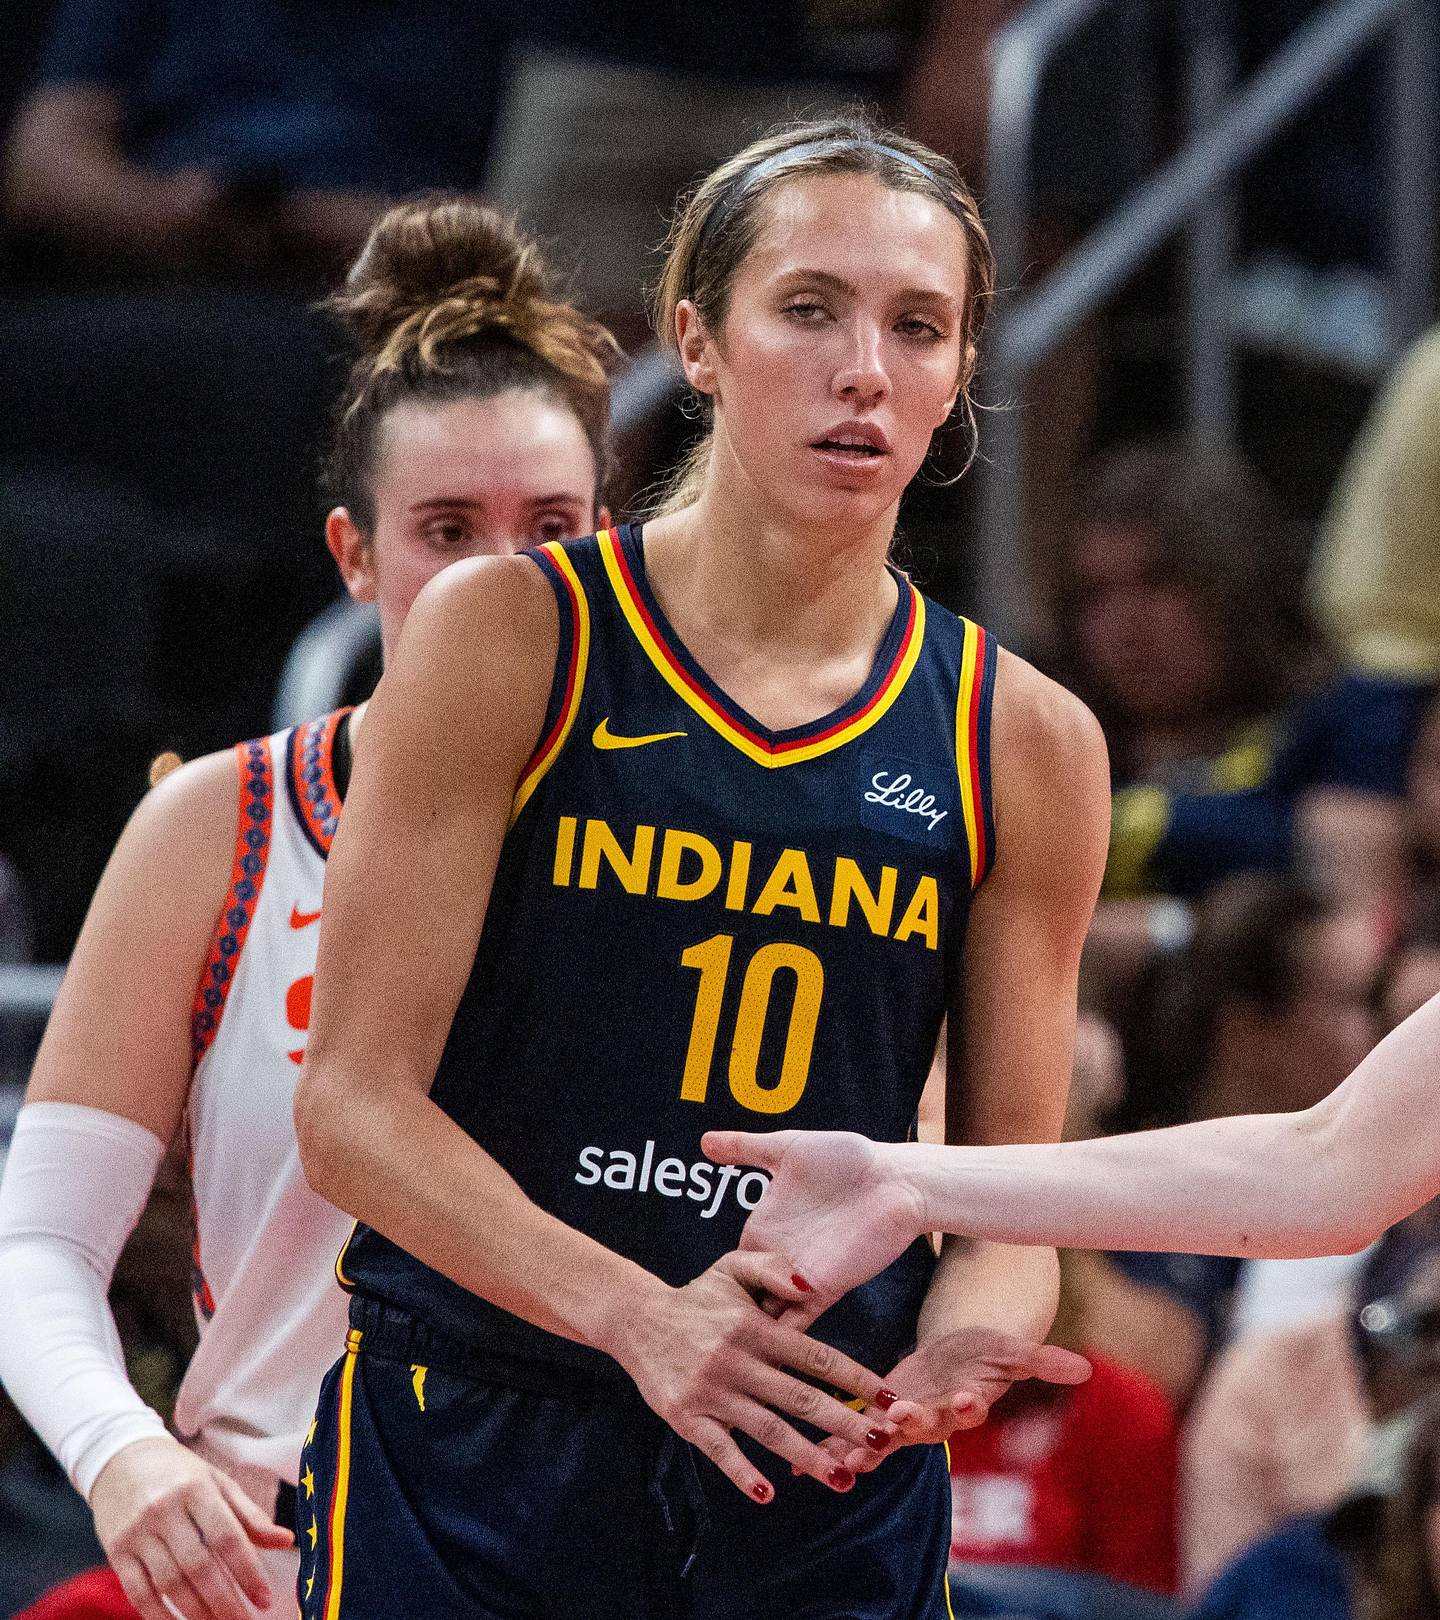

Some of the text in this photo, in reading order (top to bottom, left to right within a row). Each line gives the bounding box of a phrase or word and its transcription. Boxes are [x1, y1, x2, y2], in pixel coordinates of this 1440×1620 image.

[864, 771, 948, 831] Lilly
[552, 816, 940, 951] INDIANA
[680, 933, 825, 1115] 10
[575, 1140, 770, 1219] salesfo
